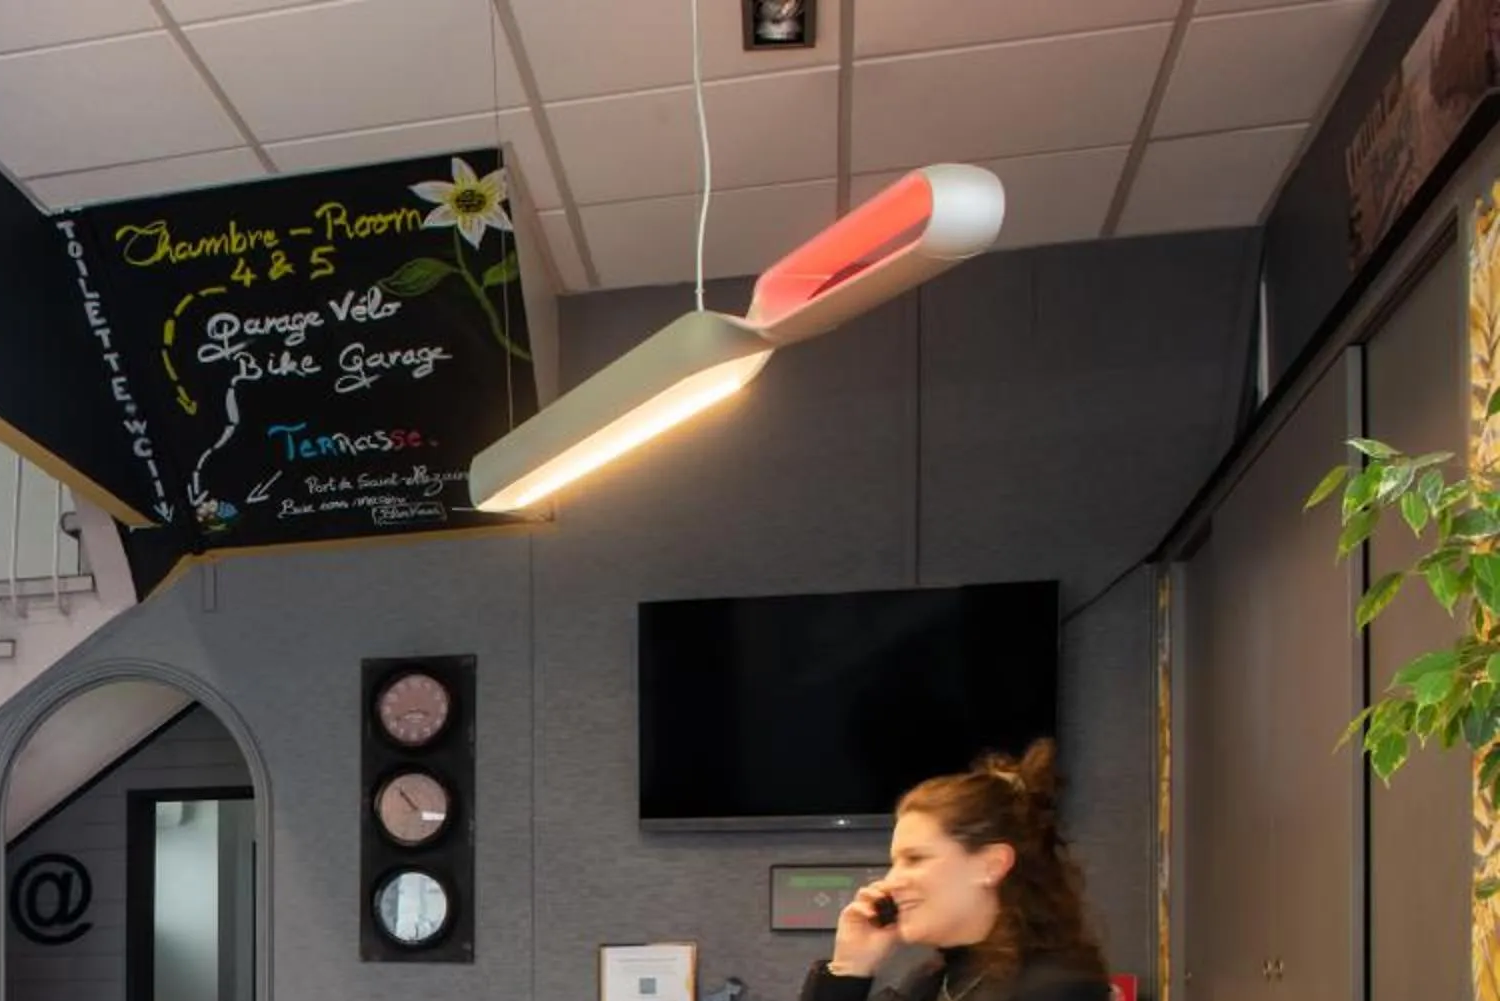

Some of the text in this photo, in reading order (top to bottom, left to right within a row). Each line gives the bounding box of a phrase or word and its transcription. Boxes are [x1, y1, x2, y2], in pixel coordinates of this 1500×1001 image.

[315, 202, 426, 240] Room
[230, 258, 257, 287] 4
[310, 246, 338, 280] 5
[329, 286, 402, 323] Vélo
[231, 352, 322, 387] Bike
